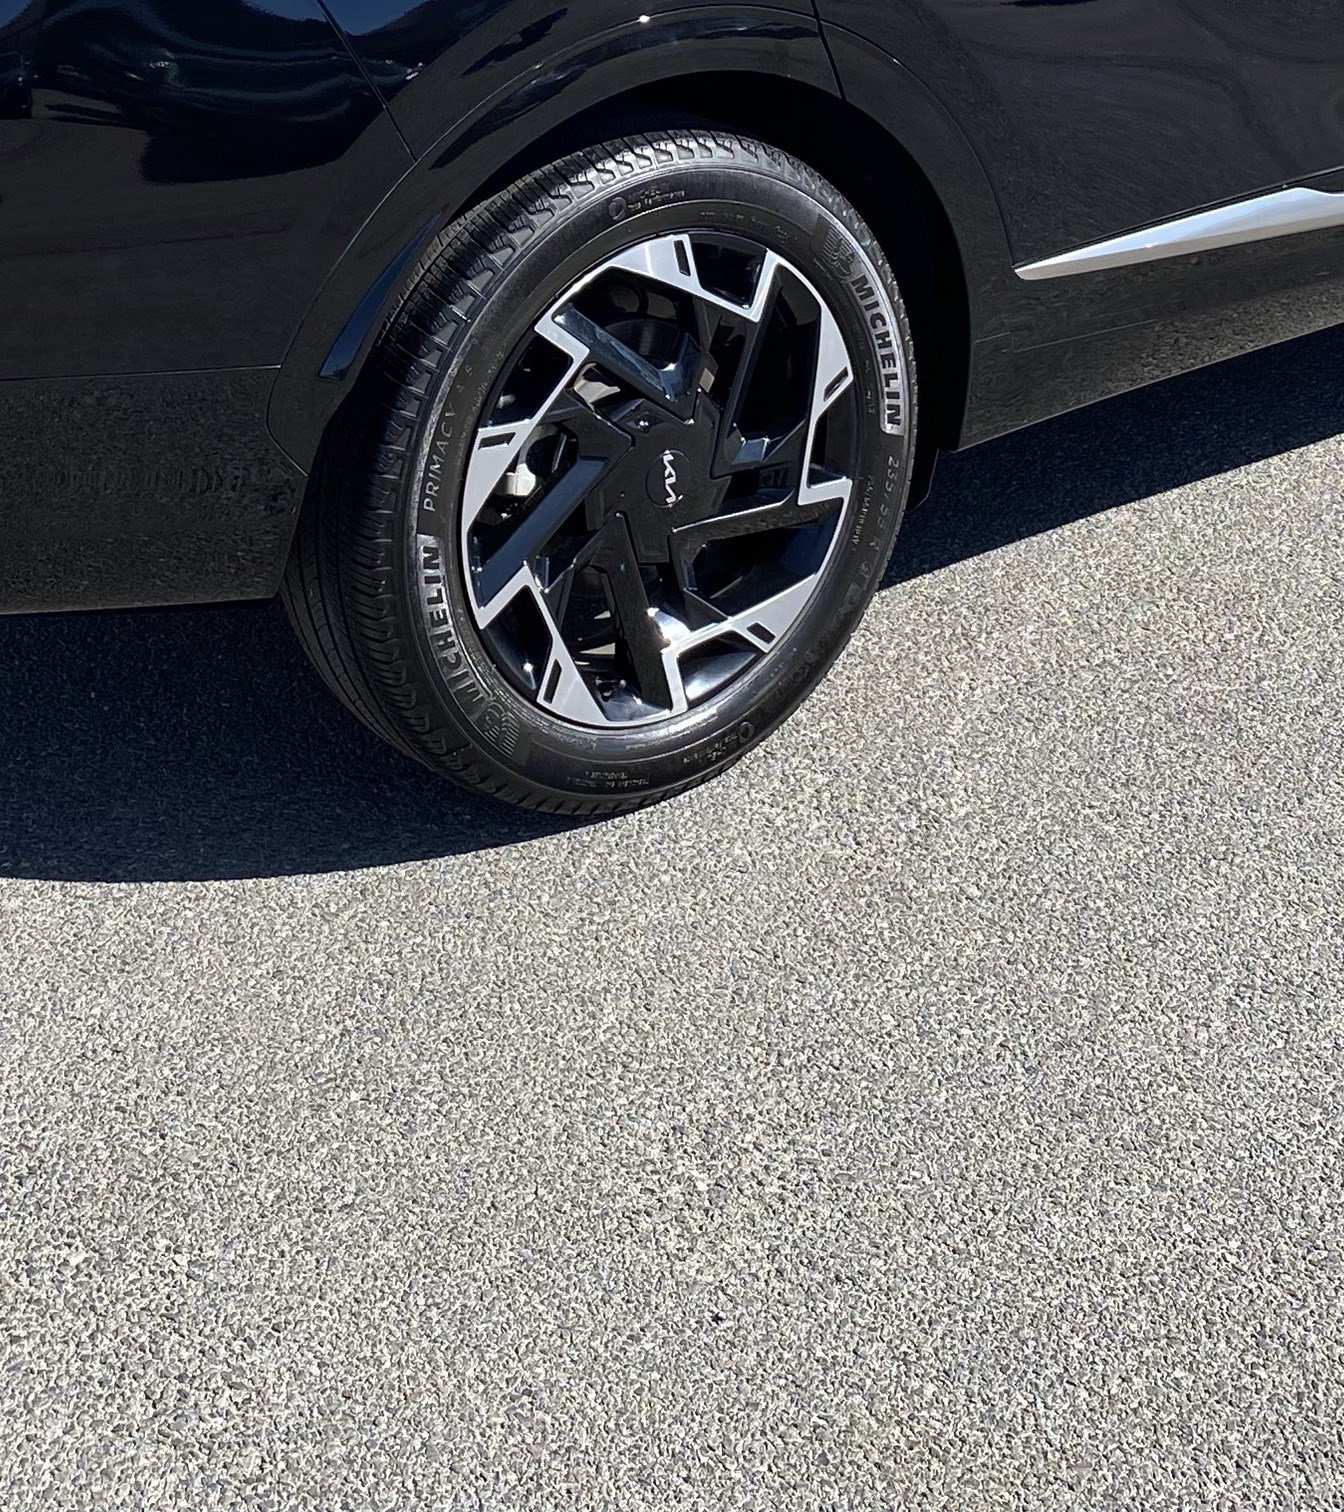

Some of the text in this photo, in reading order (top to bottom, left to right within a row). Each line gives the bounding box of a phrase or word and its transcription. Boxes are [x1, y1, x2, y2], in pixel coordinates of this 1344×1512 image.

[851, 273, 902, 427] MICHELIN
[423, 401, 458, 512] PRIMACY
[422, 545, 486, 715] MICHELIN
